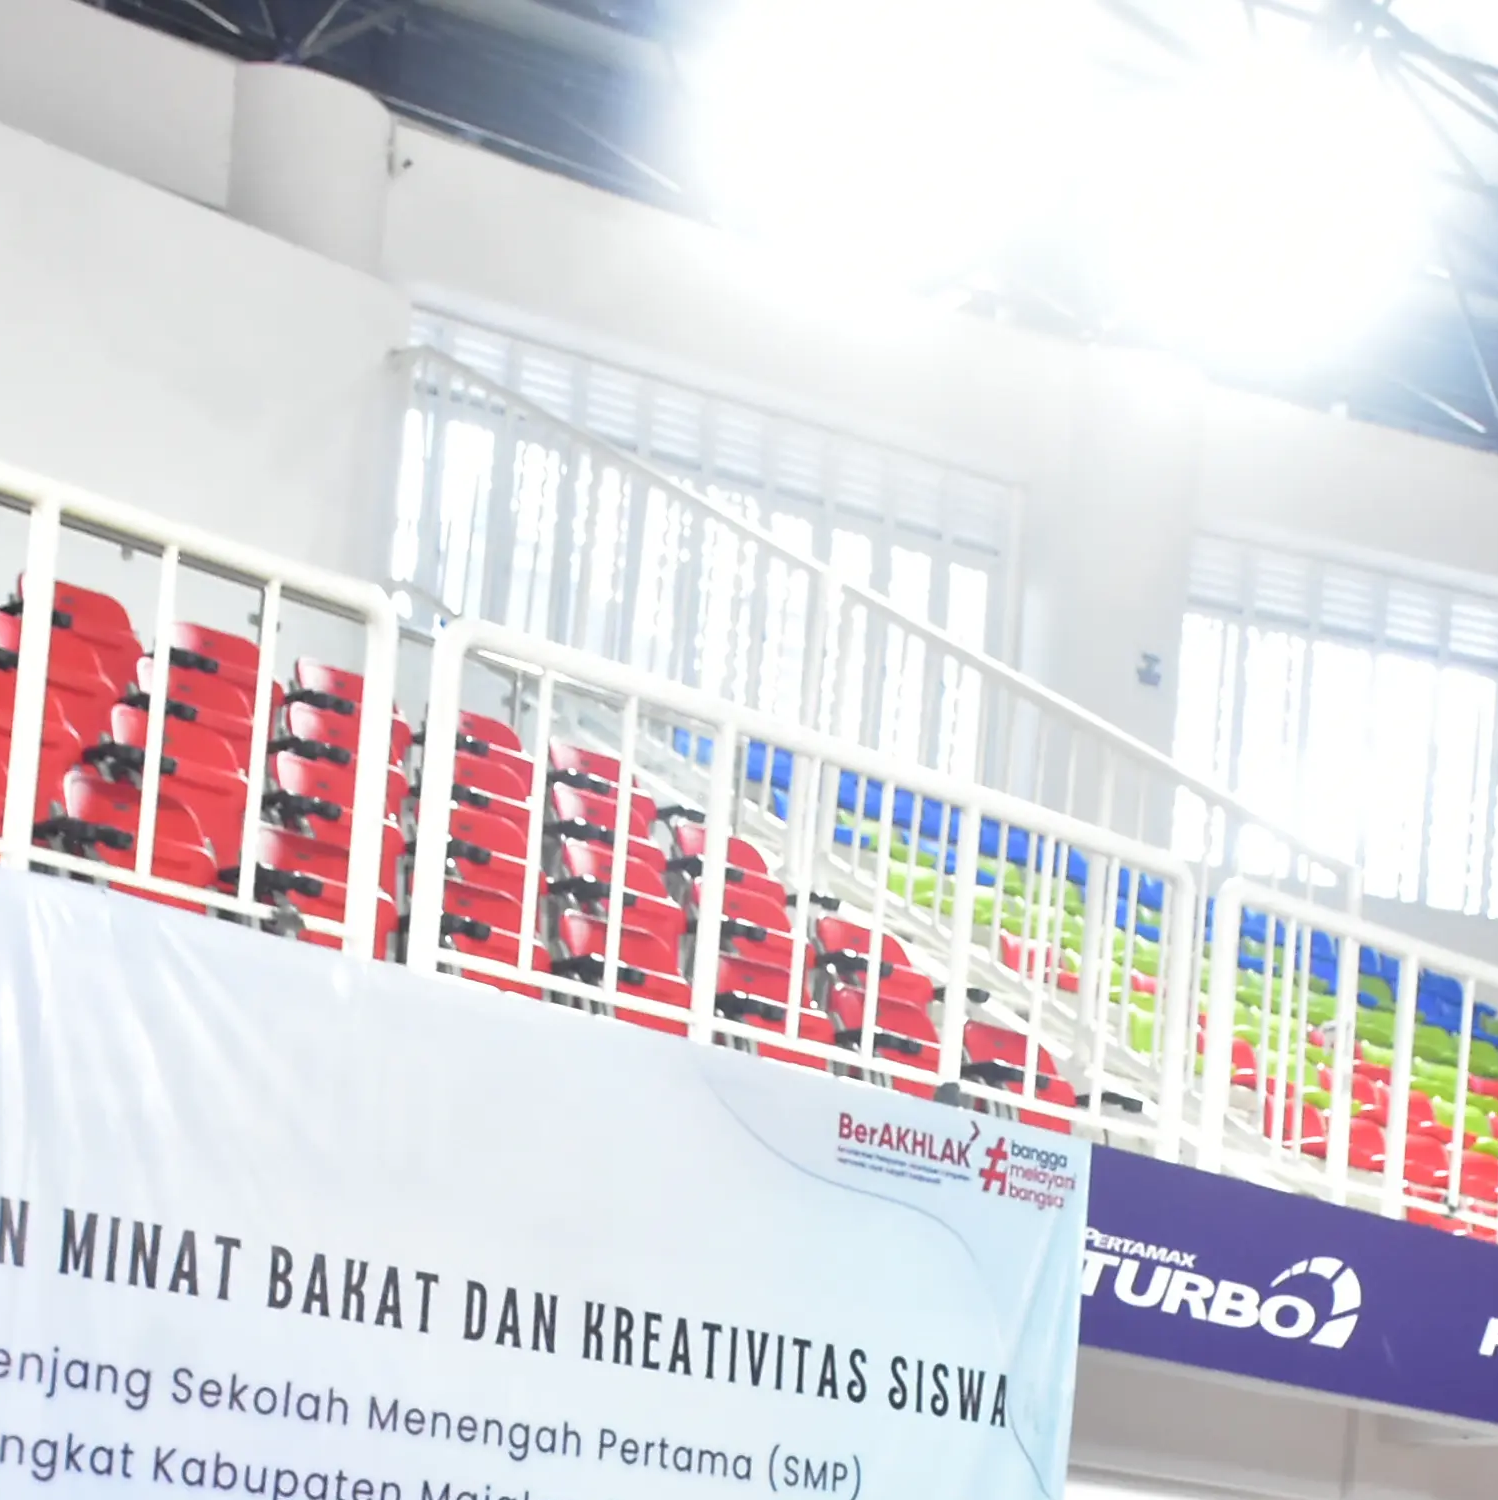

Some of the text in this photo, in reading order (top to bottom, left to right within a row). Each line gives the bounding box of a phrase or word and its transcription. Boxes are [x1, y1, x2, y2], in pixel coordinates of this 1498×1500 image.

[838, 1112, 972, 1169] BerAKHLAK
[1011, 1140, 1068, 1171] bangga
[1009, 1163, 1077, 1192] melayani
[1009, 1183, 1065, 1210] bangsa
[1085, 1226, 1198, 1268] PERTAMAX
[58, 1207, 242, 1301] MINAT
[266, 1244, 440, 1334] BAKAT
[463, 1279, 559, 1354] DAN
[581, 1301, 868, 1404] KREATIVITAS
[887, 1355, 1009, 1429] SISWA
[1081, 1249, 1317, 1338] TURBO
[172, 1367, 349, 1425] Sekolah
[367, 1396, 583, 1461] Menengah
[598, 1427, 752, 1482] Pertama
